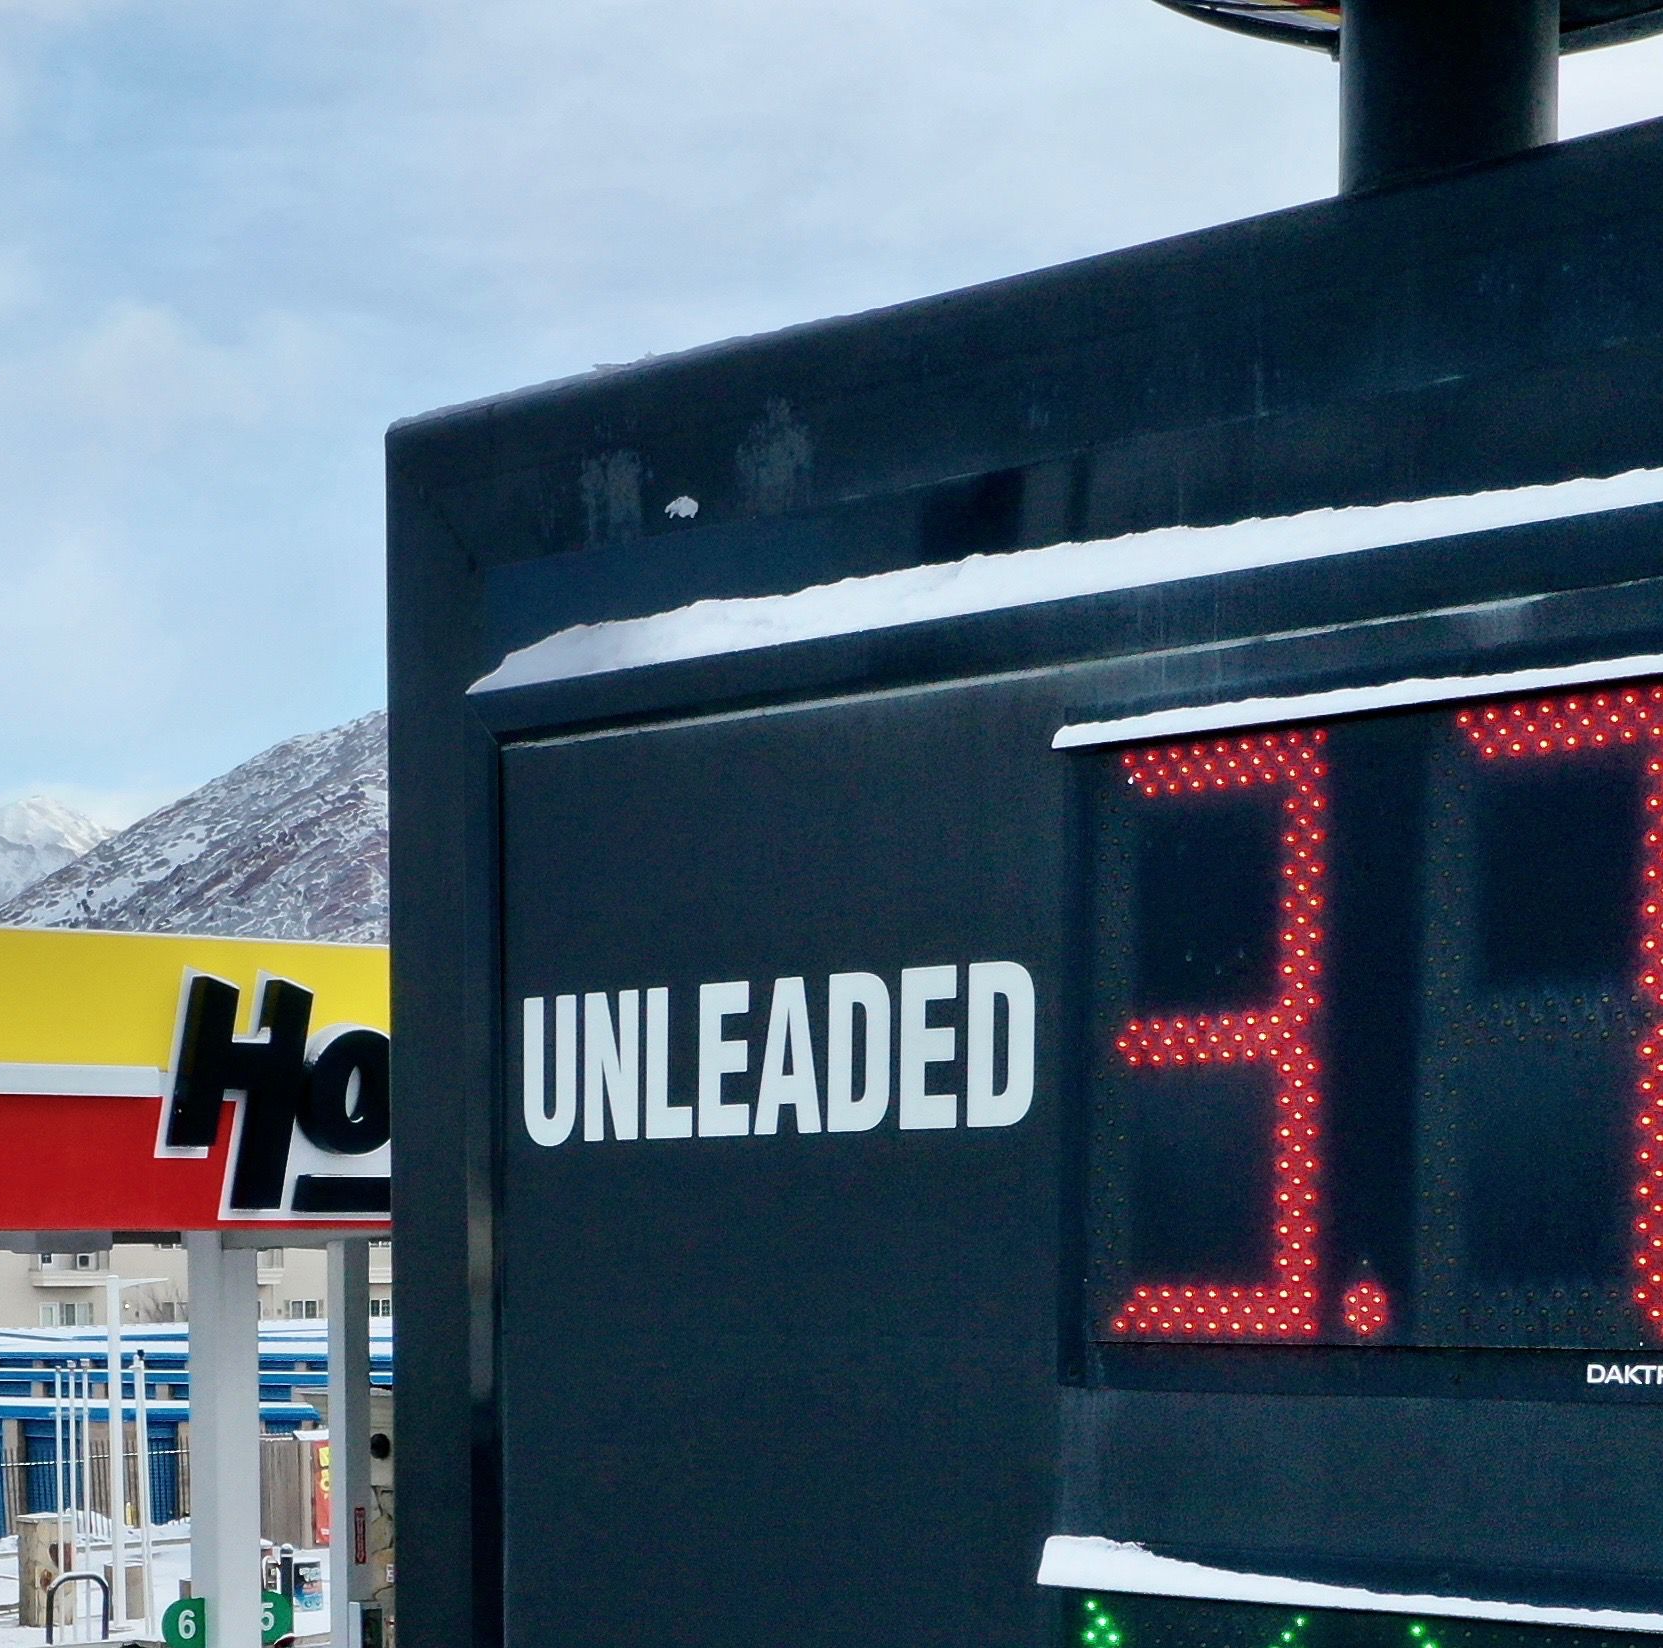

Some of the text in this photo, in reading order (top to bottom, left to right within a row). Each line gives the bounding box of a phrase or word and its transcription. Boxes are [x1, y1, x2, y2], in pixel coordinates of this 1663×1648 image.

[523, 960, 1036, 1147] UNLEADED
[178, 1609, 196, 1639] 6
[261, 1602, 275, 1632] 5
